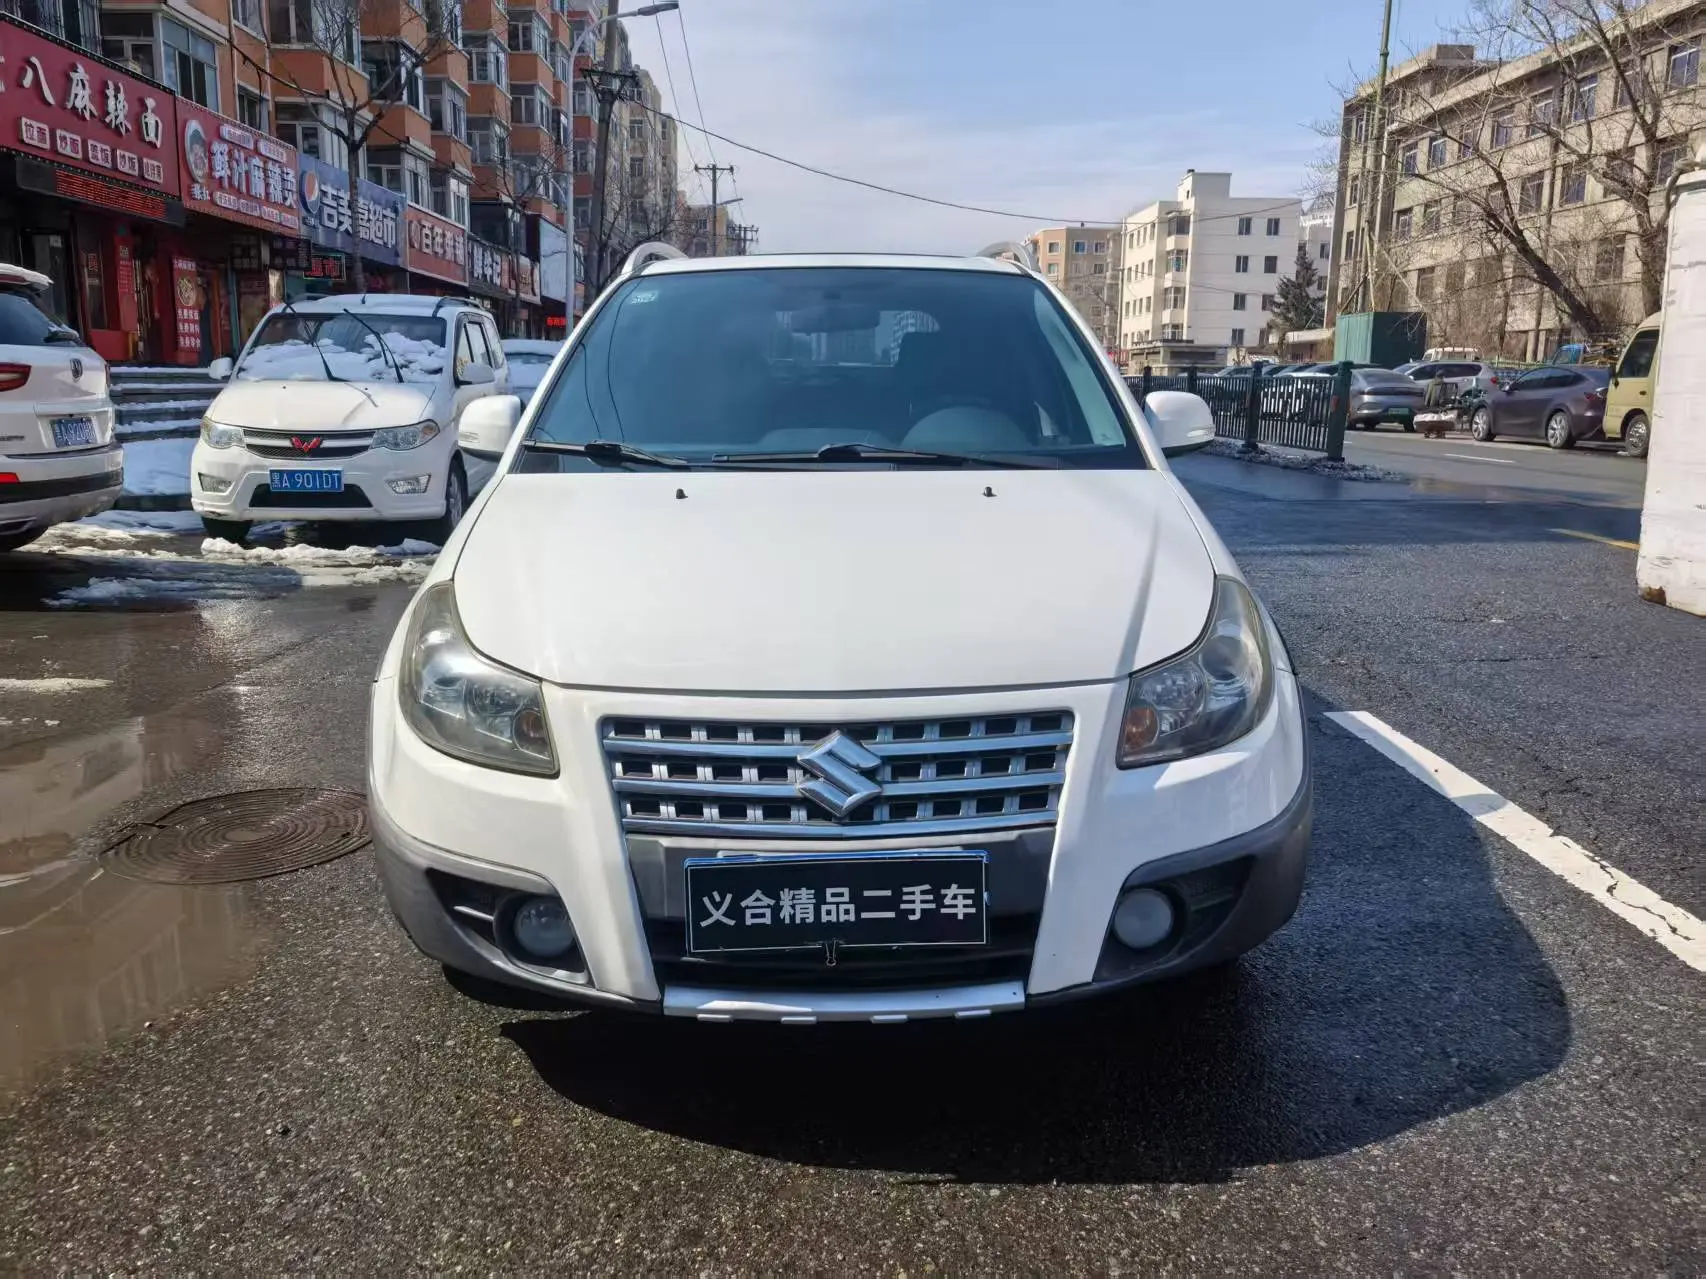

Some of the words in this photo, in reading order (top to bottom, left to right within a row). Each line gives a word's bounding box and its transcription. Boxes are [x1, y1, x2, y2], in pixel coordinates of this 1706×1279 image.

[0, 54, 163, 149] 八麻辣面
[58, 131, 81, 157] 炒面
[699, 883, 977, 928] 义合精品二手车
